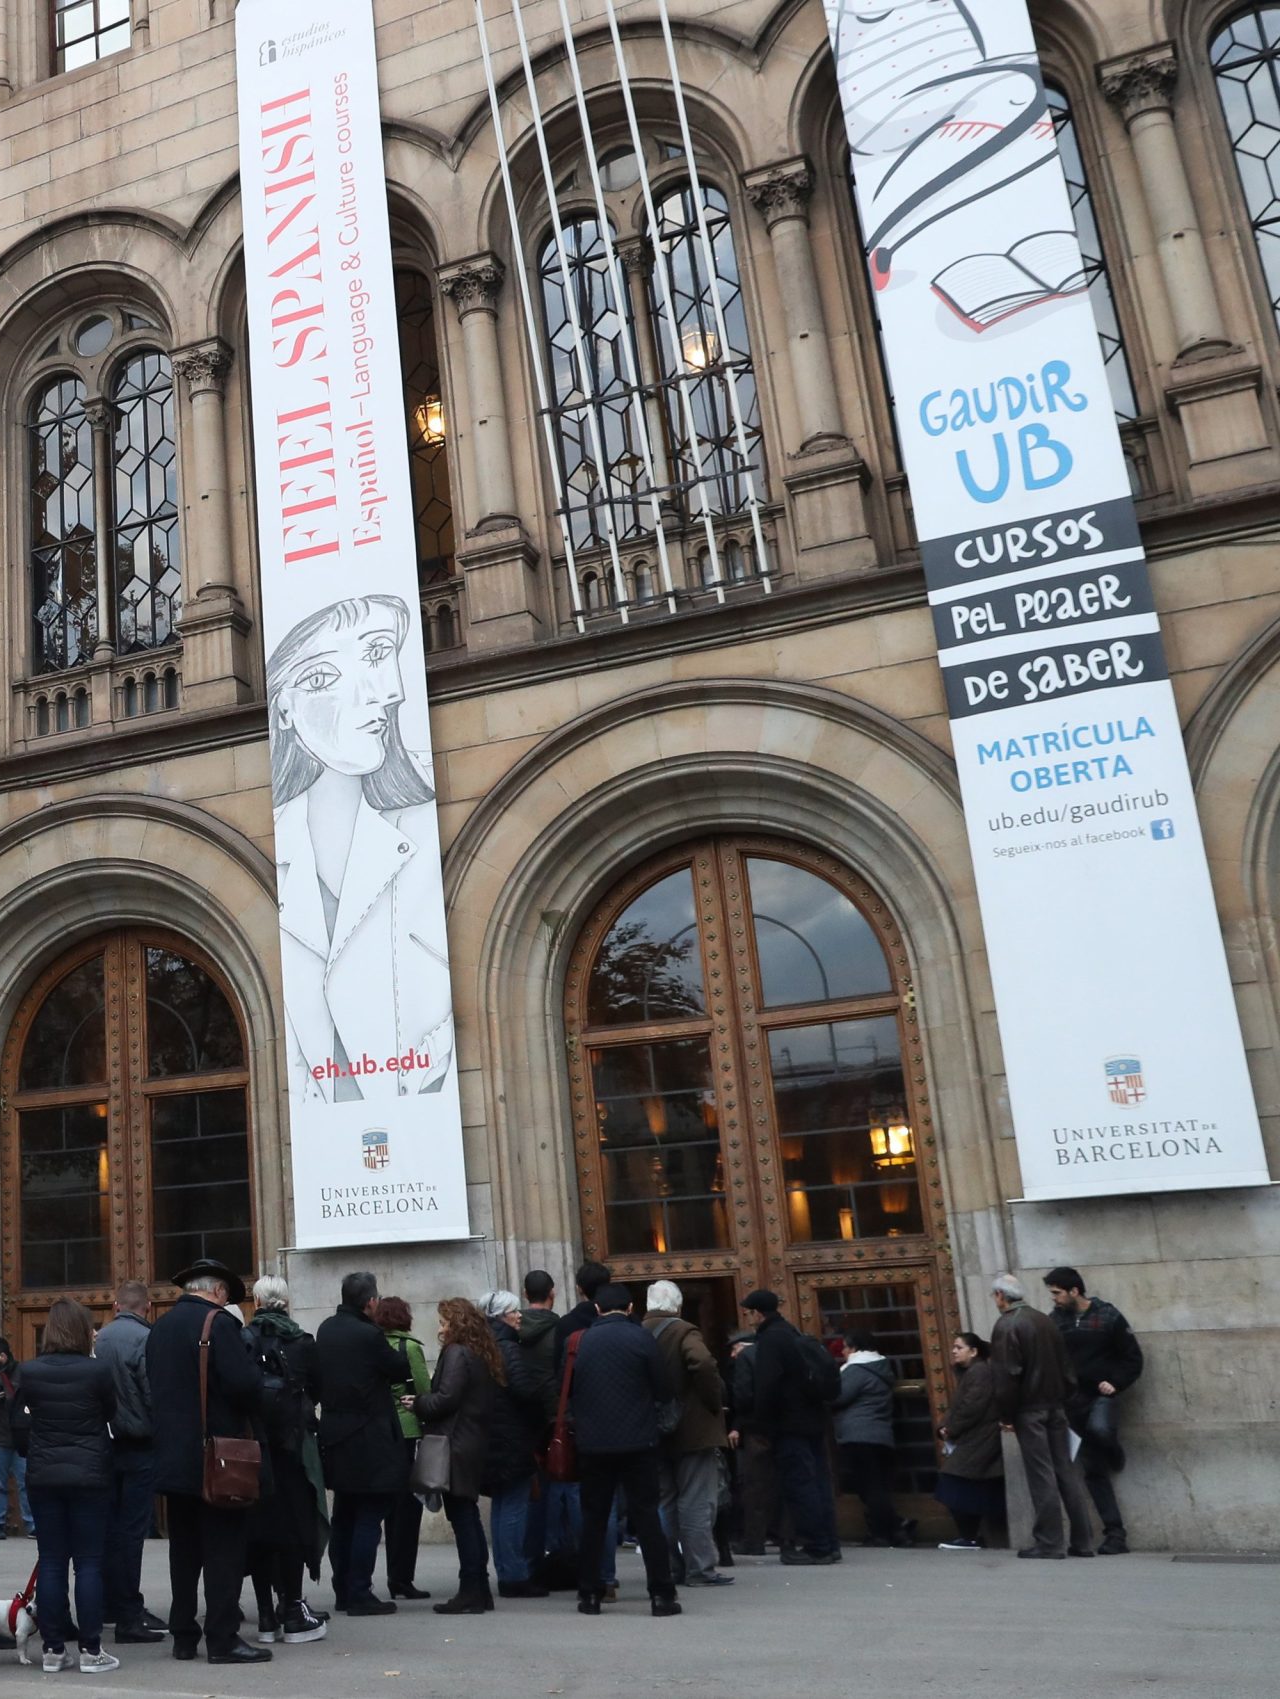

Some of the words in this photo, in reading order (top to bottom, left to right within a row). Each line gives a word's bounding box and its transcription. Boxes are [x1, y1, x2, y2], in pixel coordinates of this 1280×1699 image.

[281, 20, 330, 46] estudios
[333, 72, 352, 154] courses
[335, 161, 360, 246] Culture
[261, 81, 328, 370] SPANISH
[340, 251, 361, 271] &
[350, 278, 374, 399] Language
[276, 375, 340, 570] FEEL
[344, 419, 388, 548] Español
[955, 422, 1074, 504] UB
[976, 716, 1156, 766] MATRÍCULA
[1009, 753, 1134, 793] OBERTA
[988, 788, 1170, 832] ub.edu/gaudirub
[992, 838, 1068, 858] Segueix-nos
[1070, 833, 1082, 847] al
[1085, 825, 1147, 845] facebook
[312, 1048, 431, 1080] eh.ub.edu
[1052, 1118, 1199, 1145] UNIVERSITAT
[1055, 1136, 1224, 1166] BARCELONA
[320, 1181, 425, 1202] UNIVERSITAT
[321, 1196, 439, 1219] BARCELONA
